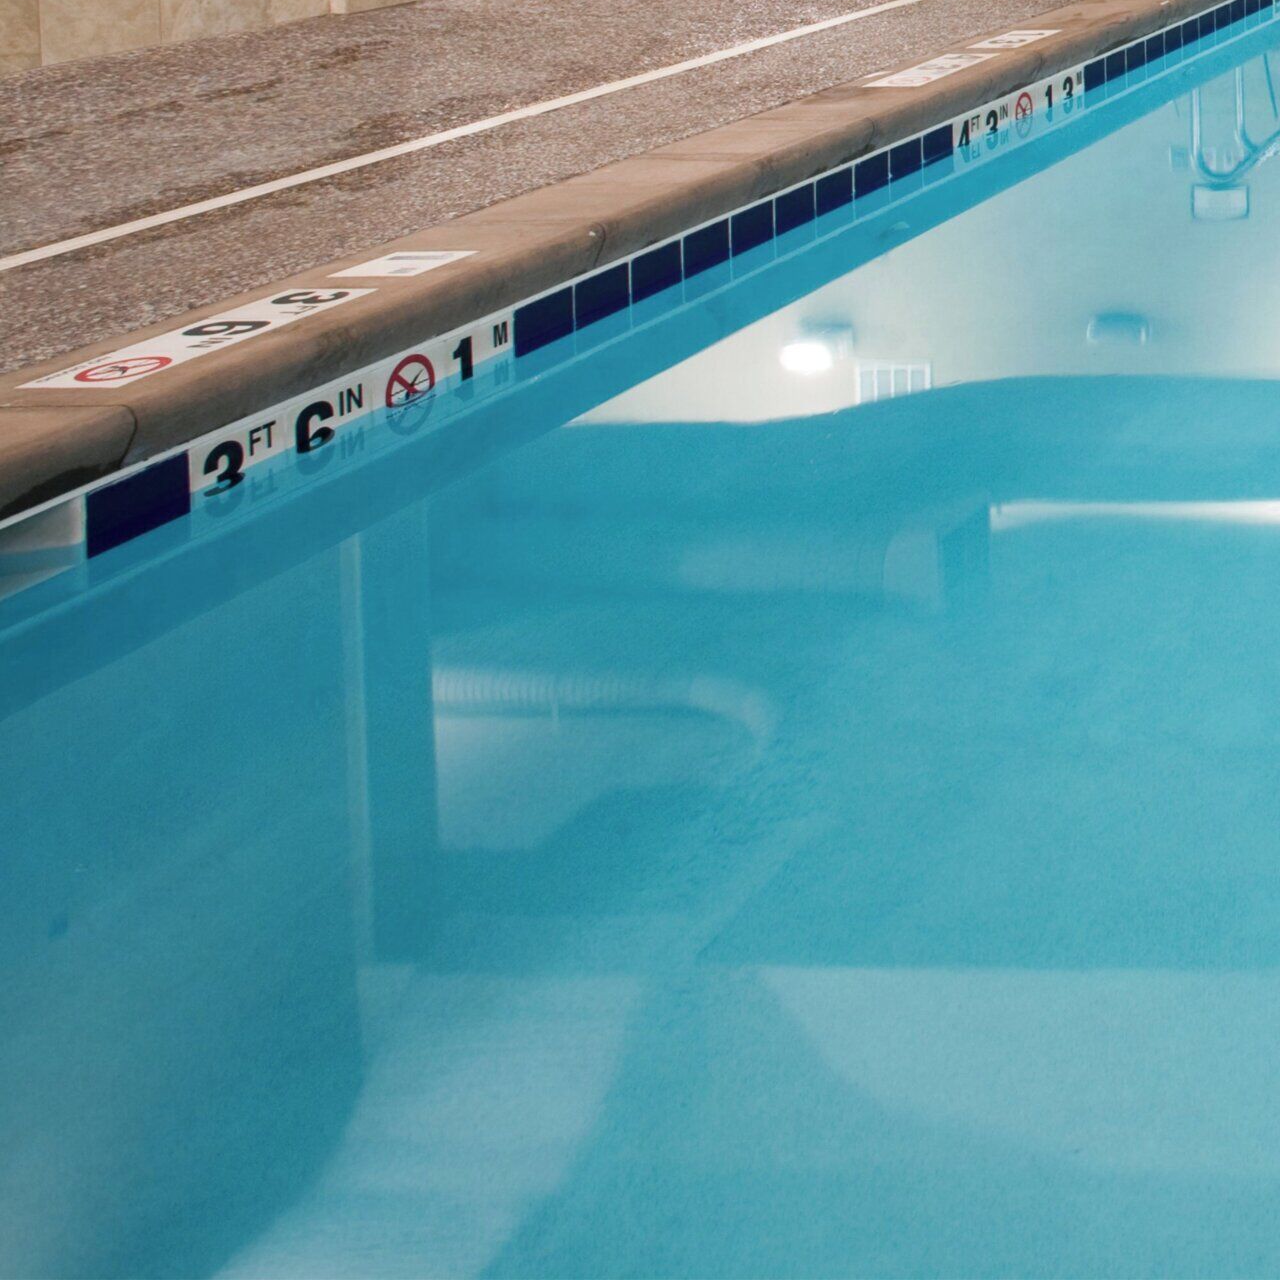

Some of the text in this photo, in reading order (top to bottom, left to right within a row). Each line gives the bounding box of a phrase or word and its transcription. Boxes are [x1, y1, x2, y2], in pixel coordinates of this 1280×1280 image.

[957, 118, 971, 148] 4
[971, 114, 982, 133] FT
[985, 109, 999, 136] 3
[999, 103, 1009, 121] IN
[270, 290, 352, 305] 3
[181, 320, 272, 337] 6
[202, 320, 508, 497] 3 FT 6 IN 1 M
